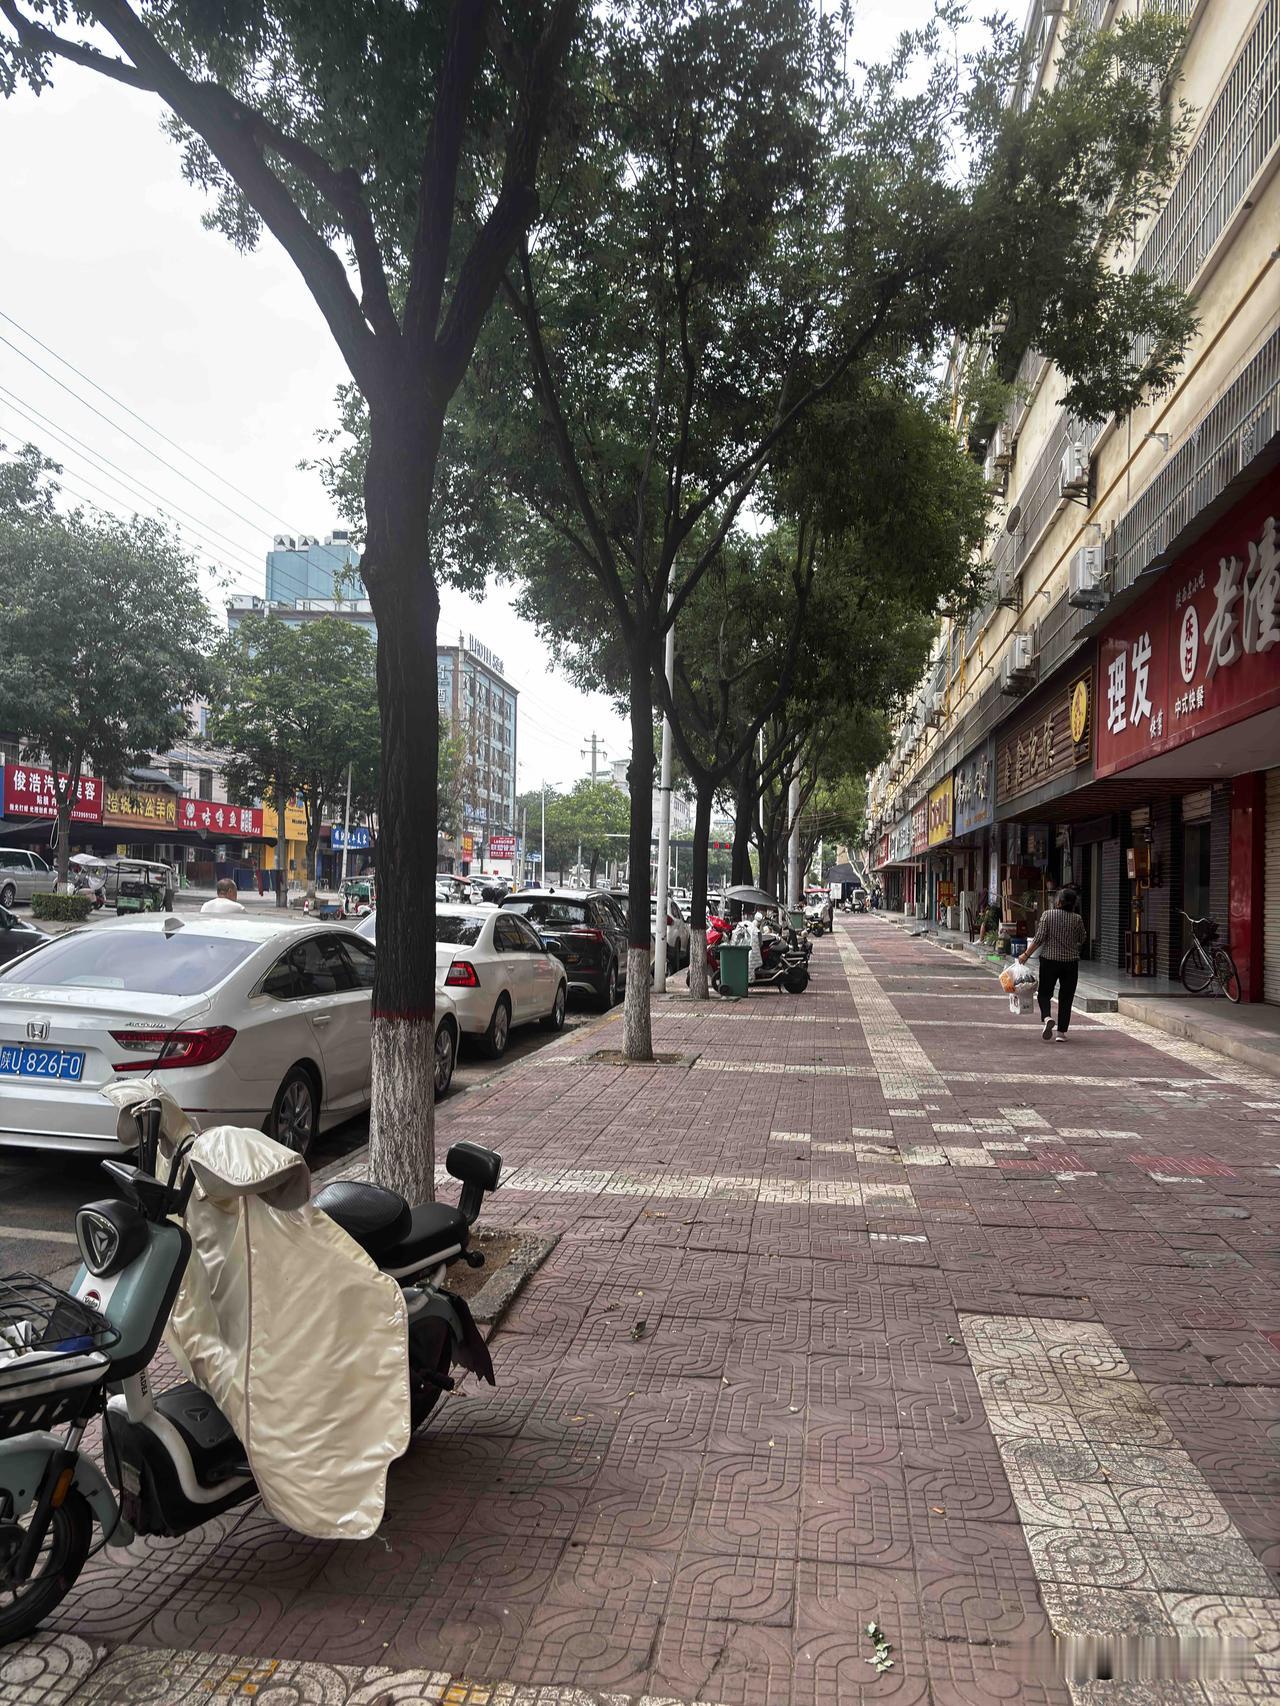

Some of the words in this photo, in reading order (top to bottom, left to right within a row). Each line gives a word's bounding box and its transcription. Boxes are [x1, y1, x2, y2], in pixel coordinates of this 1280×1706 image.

[1184, 613, 1194, 675] 乐记
[1107, 631, 1152, 735] 理发
[1174, 685, 1205, 719] 中式快餐
